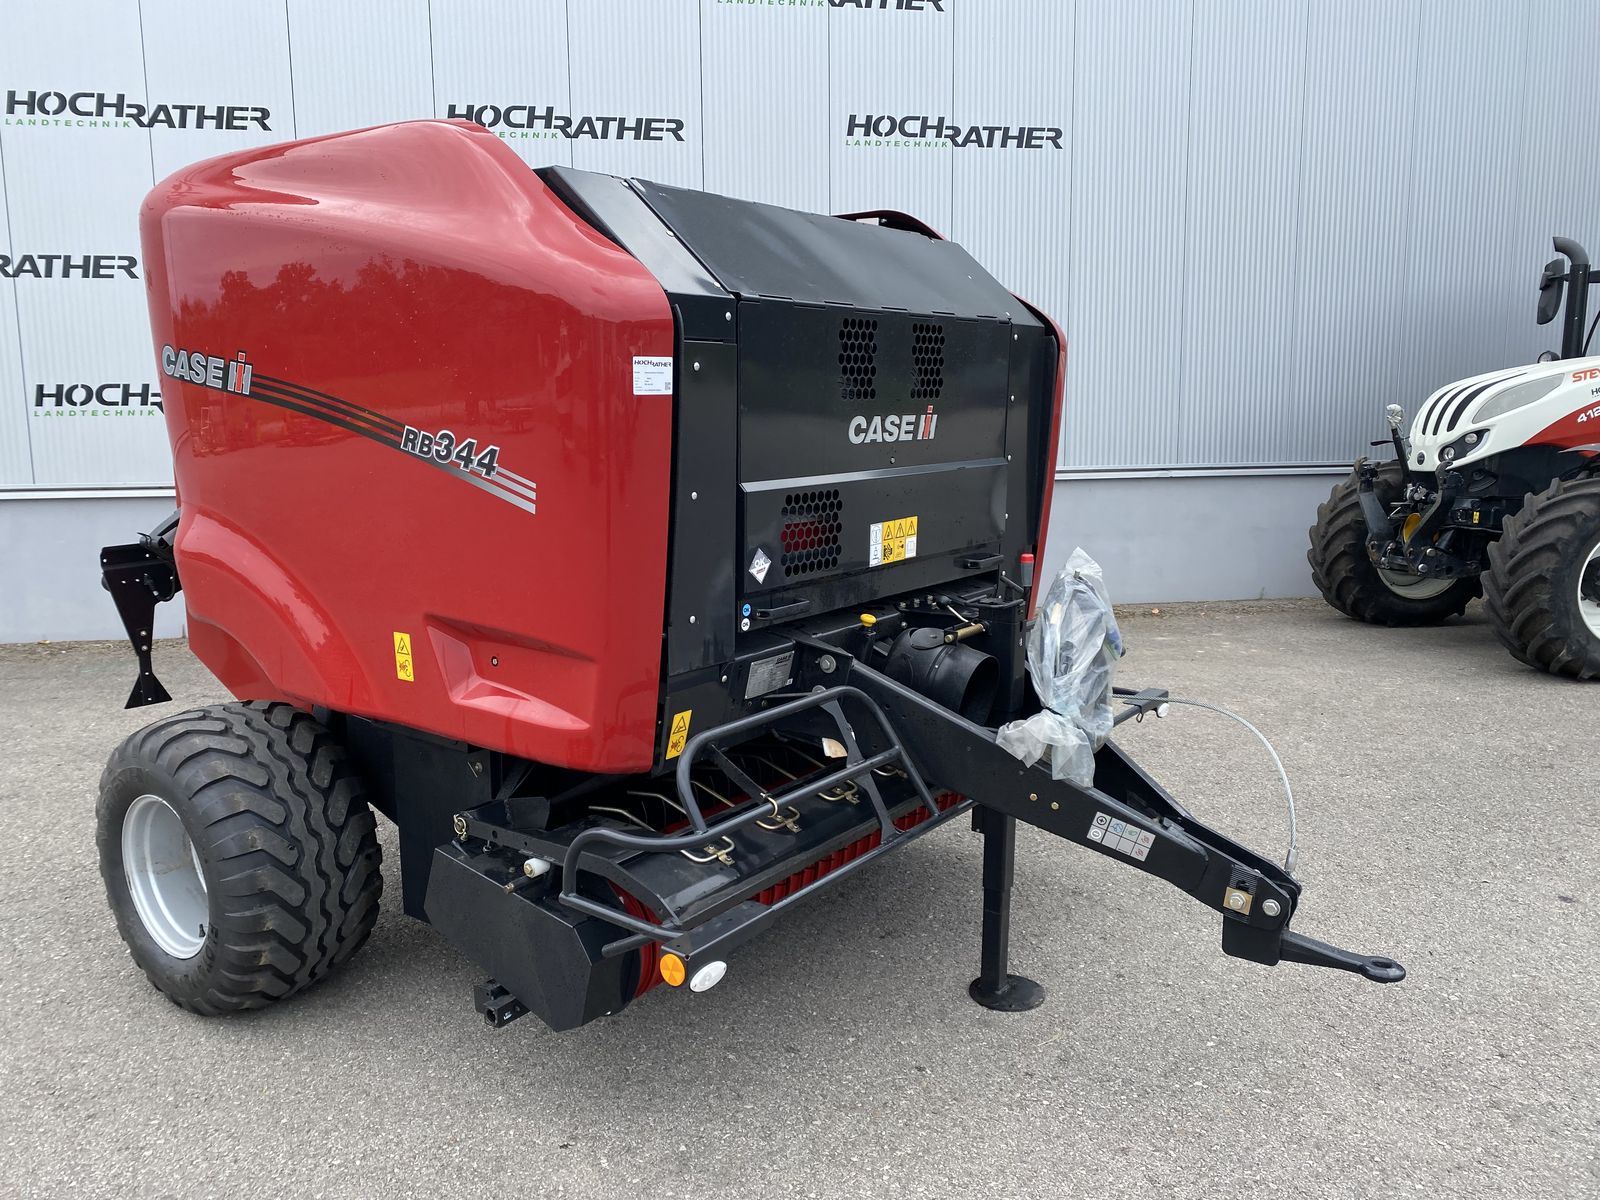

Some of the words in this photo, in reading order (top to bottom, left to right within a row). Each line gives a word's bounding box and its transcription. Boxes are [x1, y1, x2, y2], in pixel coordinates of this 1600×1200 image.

[6, 90, 272, 131] HOCHRATHER
[5, 118, 131, 128] LANDTECHNIK
[447, 104, 685, 141] HOCHRATHER
[846, 114, 1063, 149] HOCHRATHER
[493, 131, 558, 139] ECHNIK
[845, 139, 948, 148] LANDTECHNIK
[162, 345, 225, 389] CASE
[634, 359, 672, 368] HOCHRATHER
[1572, 367, 1600, 383] STE
[34, 409, 155, 417] LANDTECHNIK
[848, 414, 916, 445] CASE
[400, 424, 500, 479] RB344
